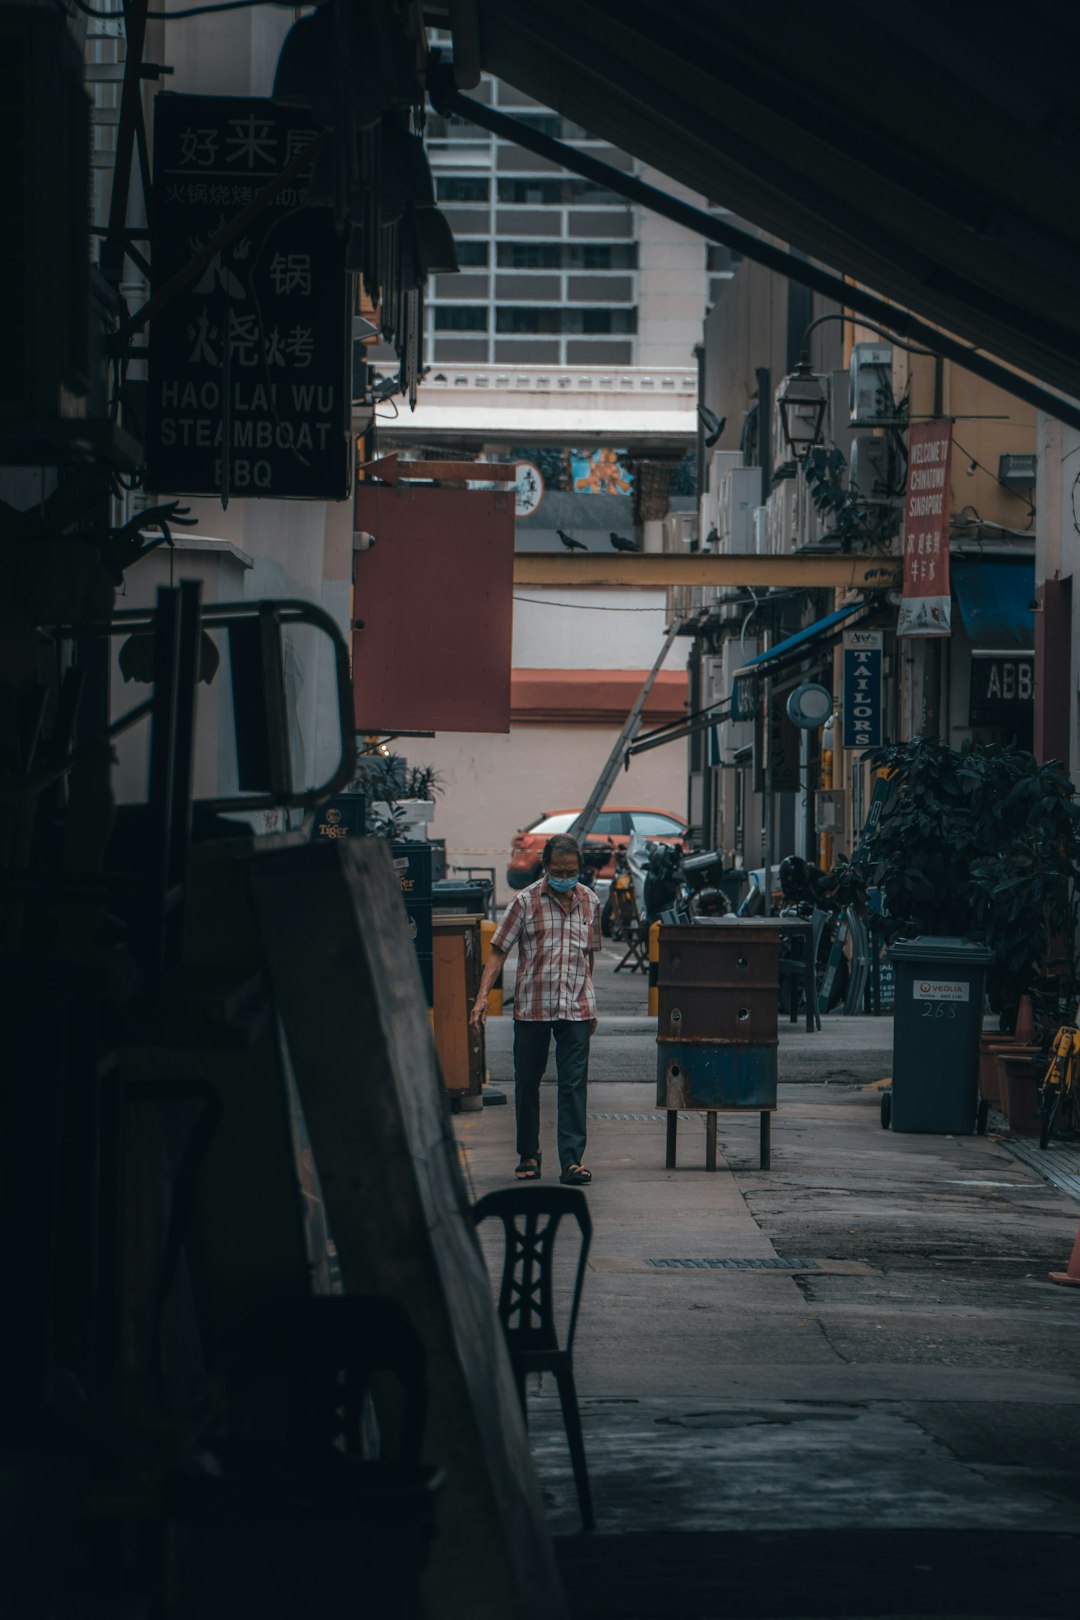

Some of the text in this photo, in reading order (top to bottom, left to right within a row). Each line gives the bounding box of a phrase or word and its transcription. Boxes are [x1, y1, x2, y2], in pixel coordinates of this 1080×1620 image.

[161, 380, 334, 414] HAO LAI WU
[911, 441, 941, 465] WELCOME
[910, 468, 945, 491] CHINATOWN
[909, 494, 943, 517] SINGAPORE
[987, 662, 1035, 700] ABB
[852, 652, 873, 745] TAILORS
[319, 824, 349, 838] Tiger
[921, 1002, 957, 1018] 268
